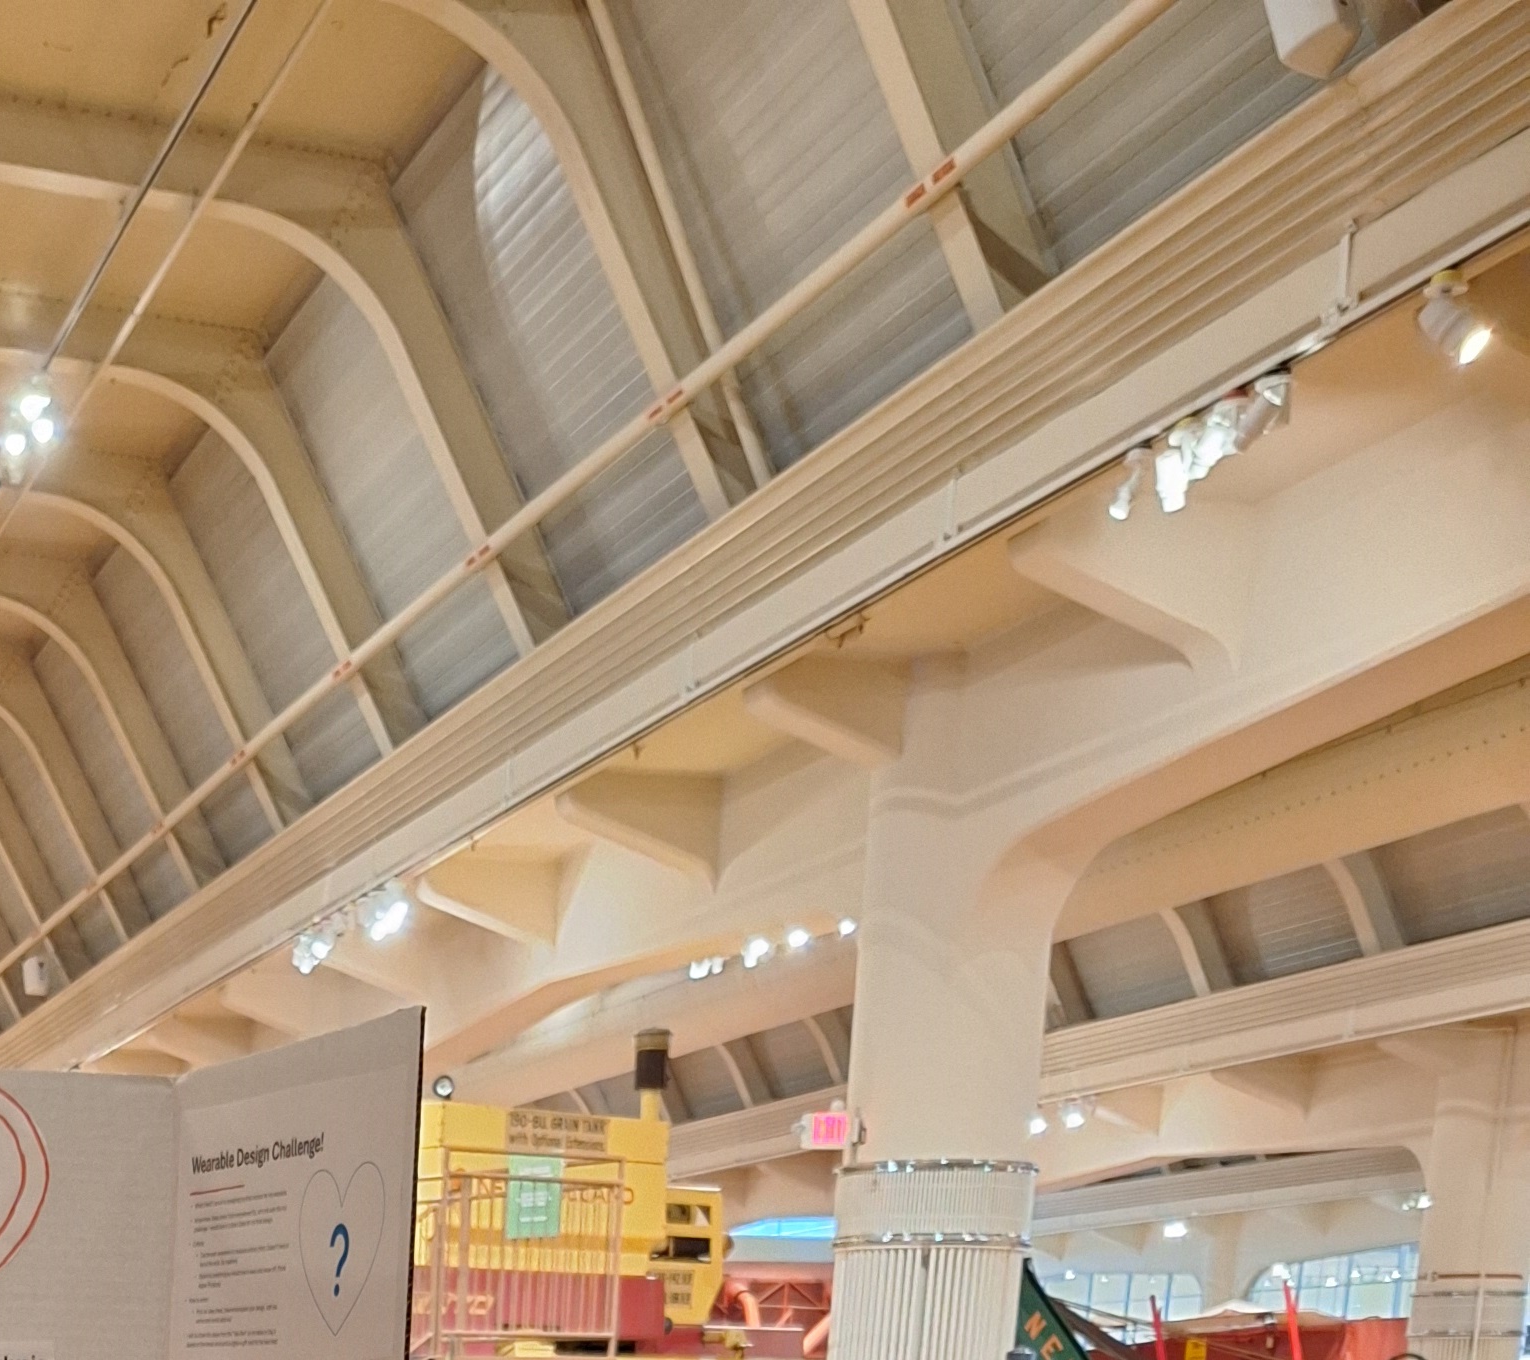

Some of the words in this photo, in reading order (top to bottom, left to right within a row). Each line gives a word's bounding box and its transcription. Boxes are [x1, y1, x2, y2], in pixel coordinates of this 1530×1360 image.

[191, 1150, 234, 1174] Wearable
[237, 1143, 269, 1167] Design
[272, 1132, 324, 1161] Challenge!
[329, 1222, 349, 1297] ?
